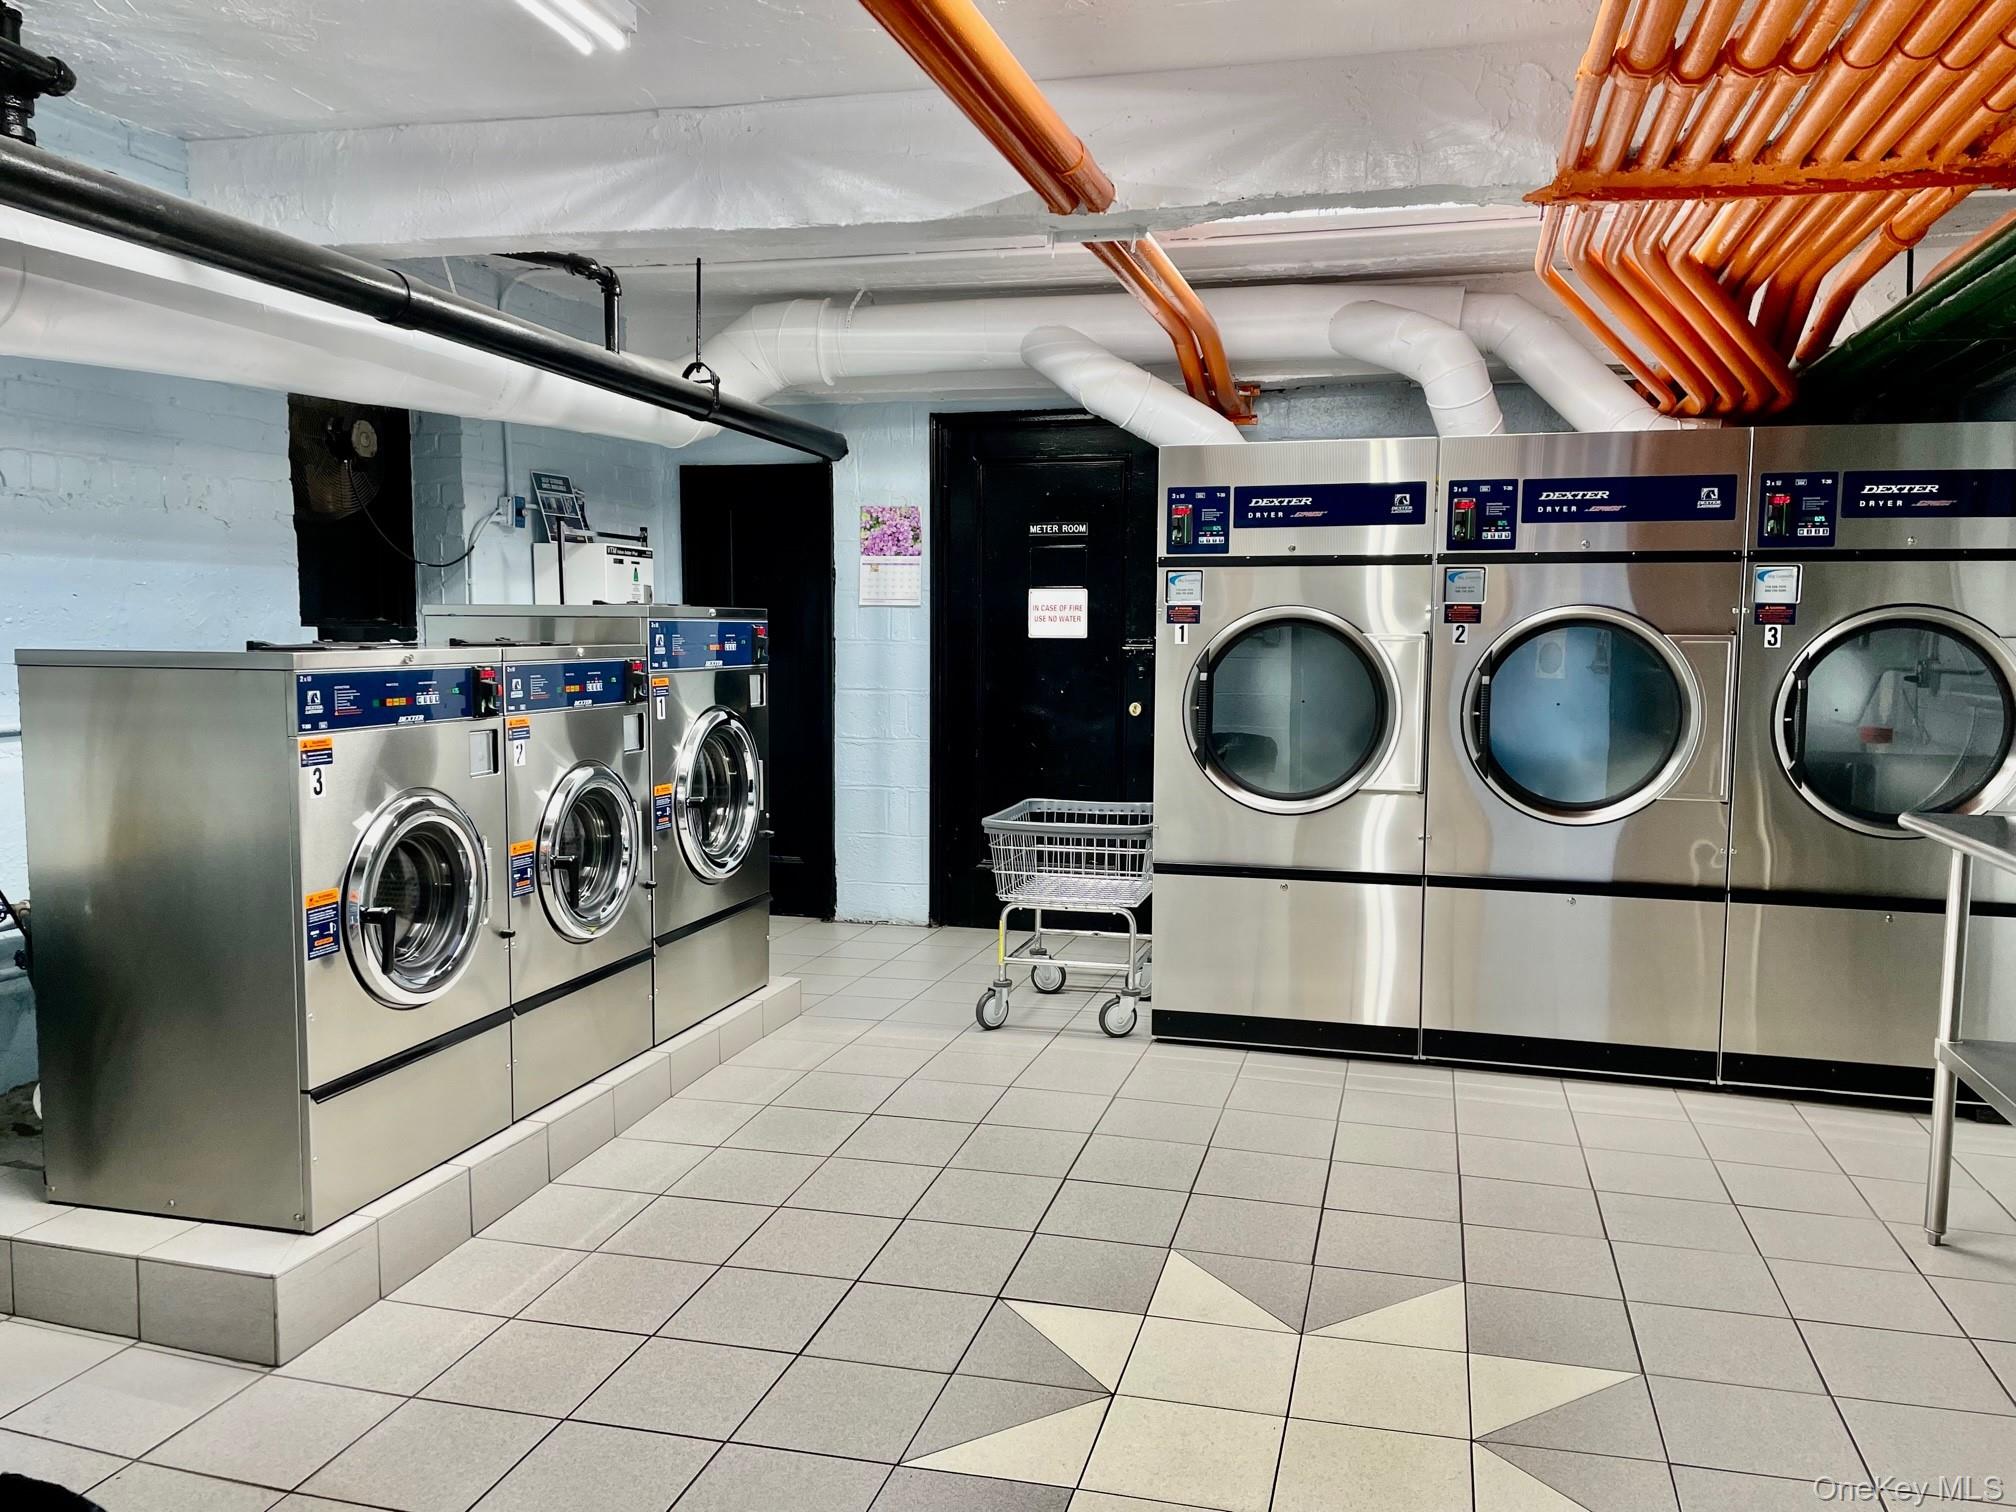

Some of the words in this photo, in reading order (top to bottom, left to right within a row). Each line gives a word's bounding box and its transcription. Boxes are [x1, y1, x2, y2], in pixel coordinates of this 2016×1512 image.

[1860, 484, 1939, 494] DEXTER
[1538, 491, 1610, 500] DEXTER
[1248, 497, 1312, 506] DEXTER
[1029, 525, 1059, 533] METER
[1062, 524, 1086, 532] ROOM
[1032, 604, 1039, 612] IN
[1040, 604, 1057, 612] CASE
[1059, 604, 1067, 612] OF
[1069, 604, 1083, 612] FIRE
[1034, 615, 1046, 623] USE
[1048, 615, 1057, 623] NO
[1059, 615, 1081, 623] WATER
[1178, 625, 1185, 642] 1
[1454, 624, 1466, 643] 2
[1767, 626, 1778, 646] 3
[659, 698, 664, 717] 1
[398, 714, 425, 723] DEXTER
[313, 767, 323, 796] 3
